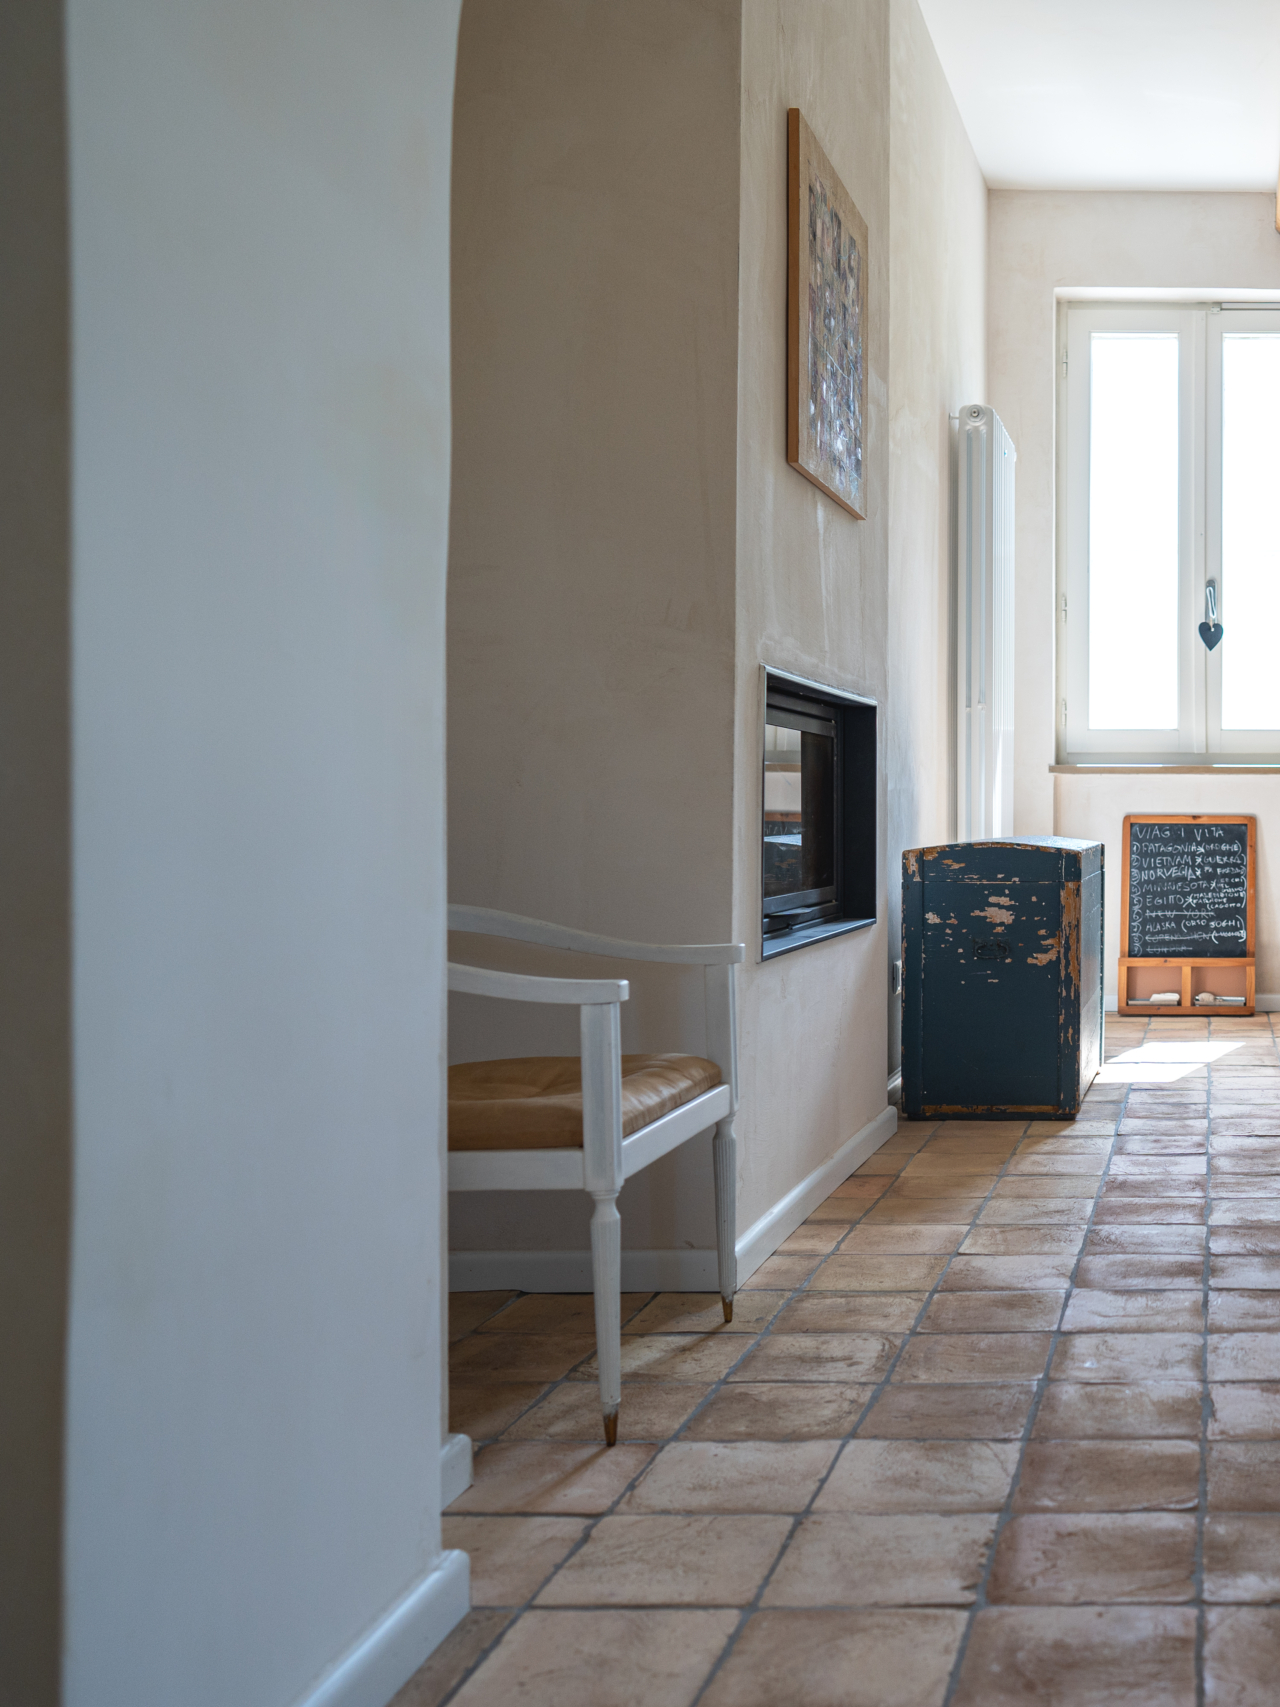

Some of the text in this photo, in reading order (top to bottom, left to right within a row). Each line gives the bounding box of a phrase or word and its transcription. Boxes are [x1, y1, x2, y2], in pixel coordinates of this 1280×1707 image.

[1194, 826, 1224, 842] VITA
[1142, 854, 1192, 868] VIETNAM
[1141, 865, 1197, 882] NORVEGIA
[1143, 879, 1210, 893] MINNESOTA
[1146, 894, 1185, 907] EGITTO
[1145, 921, 1177, 932] ALASKA
